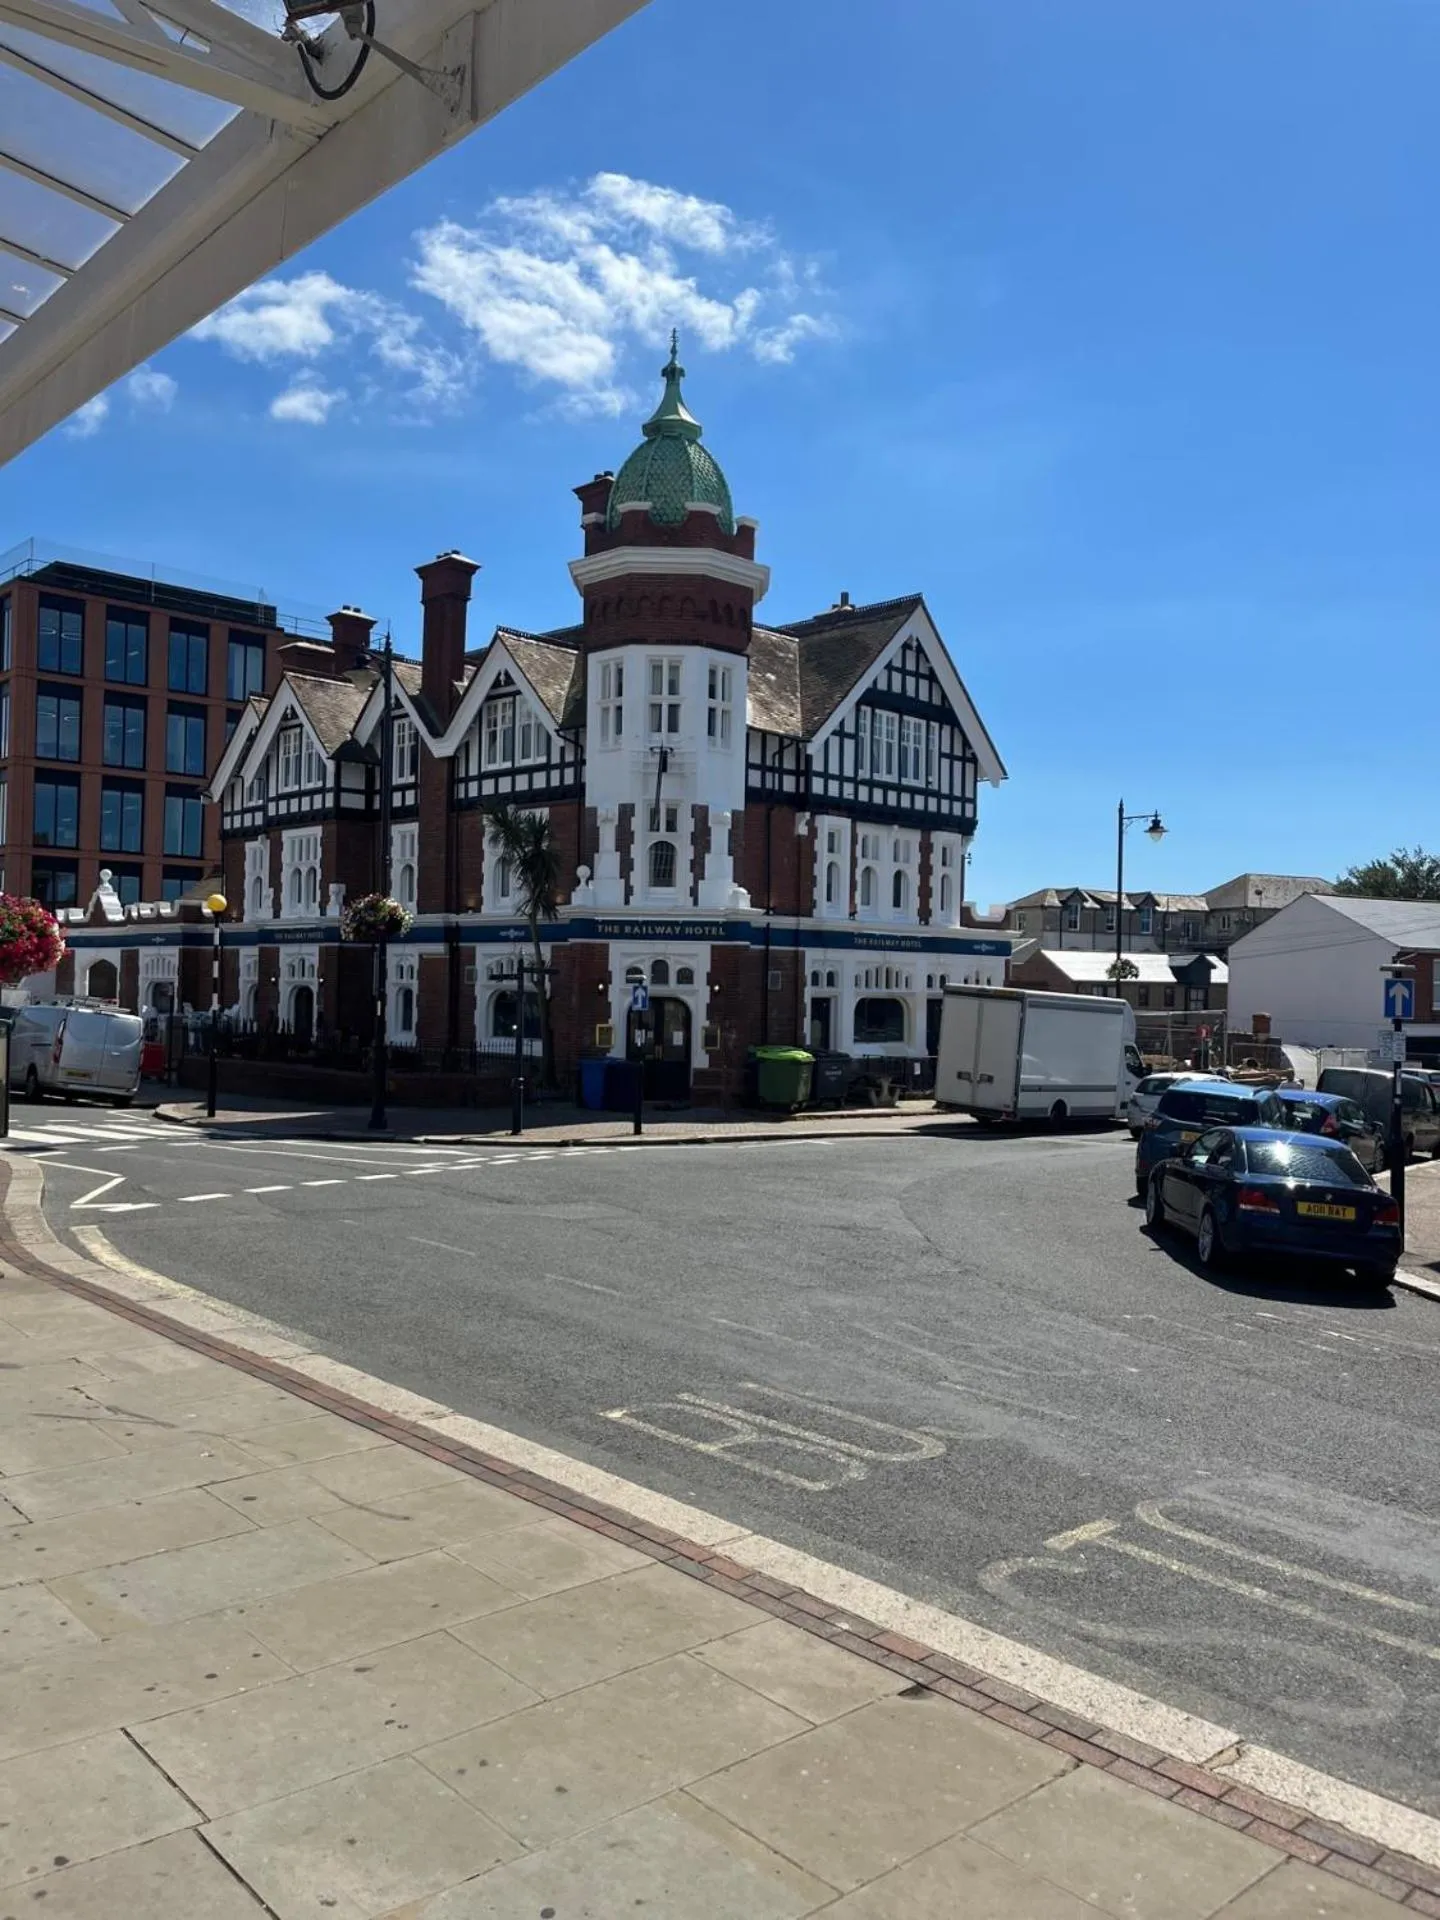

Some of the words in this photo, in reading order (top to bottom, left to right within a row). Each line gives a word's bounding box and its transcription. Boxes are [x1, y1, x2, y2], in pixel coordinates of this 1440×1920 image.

[598, 924, 620, 933] THE
[624, 924, 681, 935] RAILWAY
[685, 926, 726, 936] HOTEL
